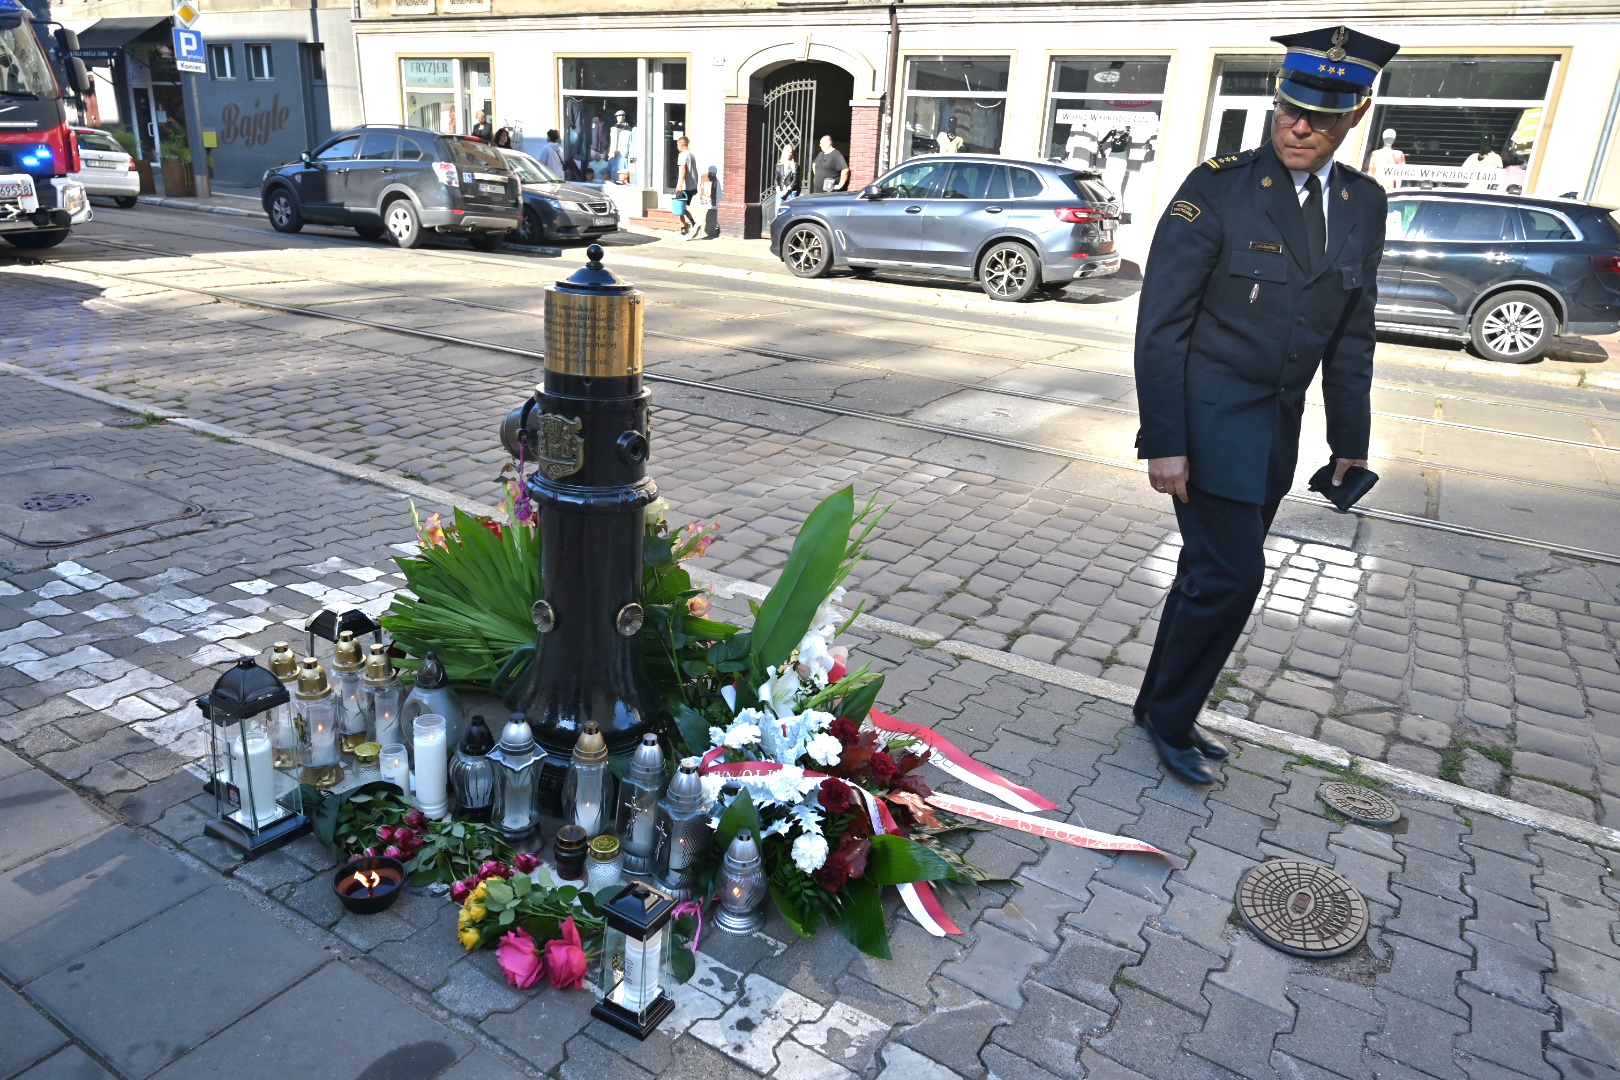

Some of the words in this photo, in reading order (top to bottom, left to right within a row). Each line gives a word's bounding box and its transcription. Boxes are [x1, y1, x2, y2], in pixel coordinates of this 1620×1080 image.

[180, 31, 198, 57] P
[180, 62, 203, 71] Koniec
[410, 62, 448, 75] FRYZJER
[220, 92, 290, 148] Bajgle
[0, 185, 30, 196] 69558
[1318, 894, 1348, 938] HYDRANT
